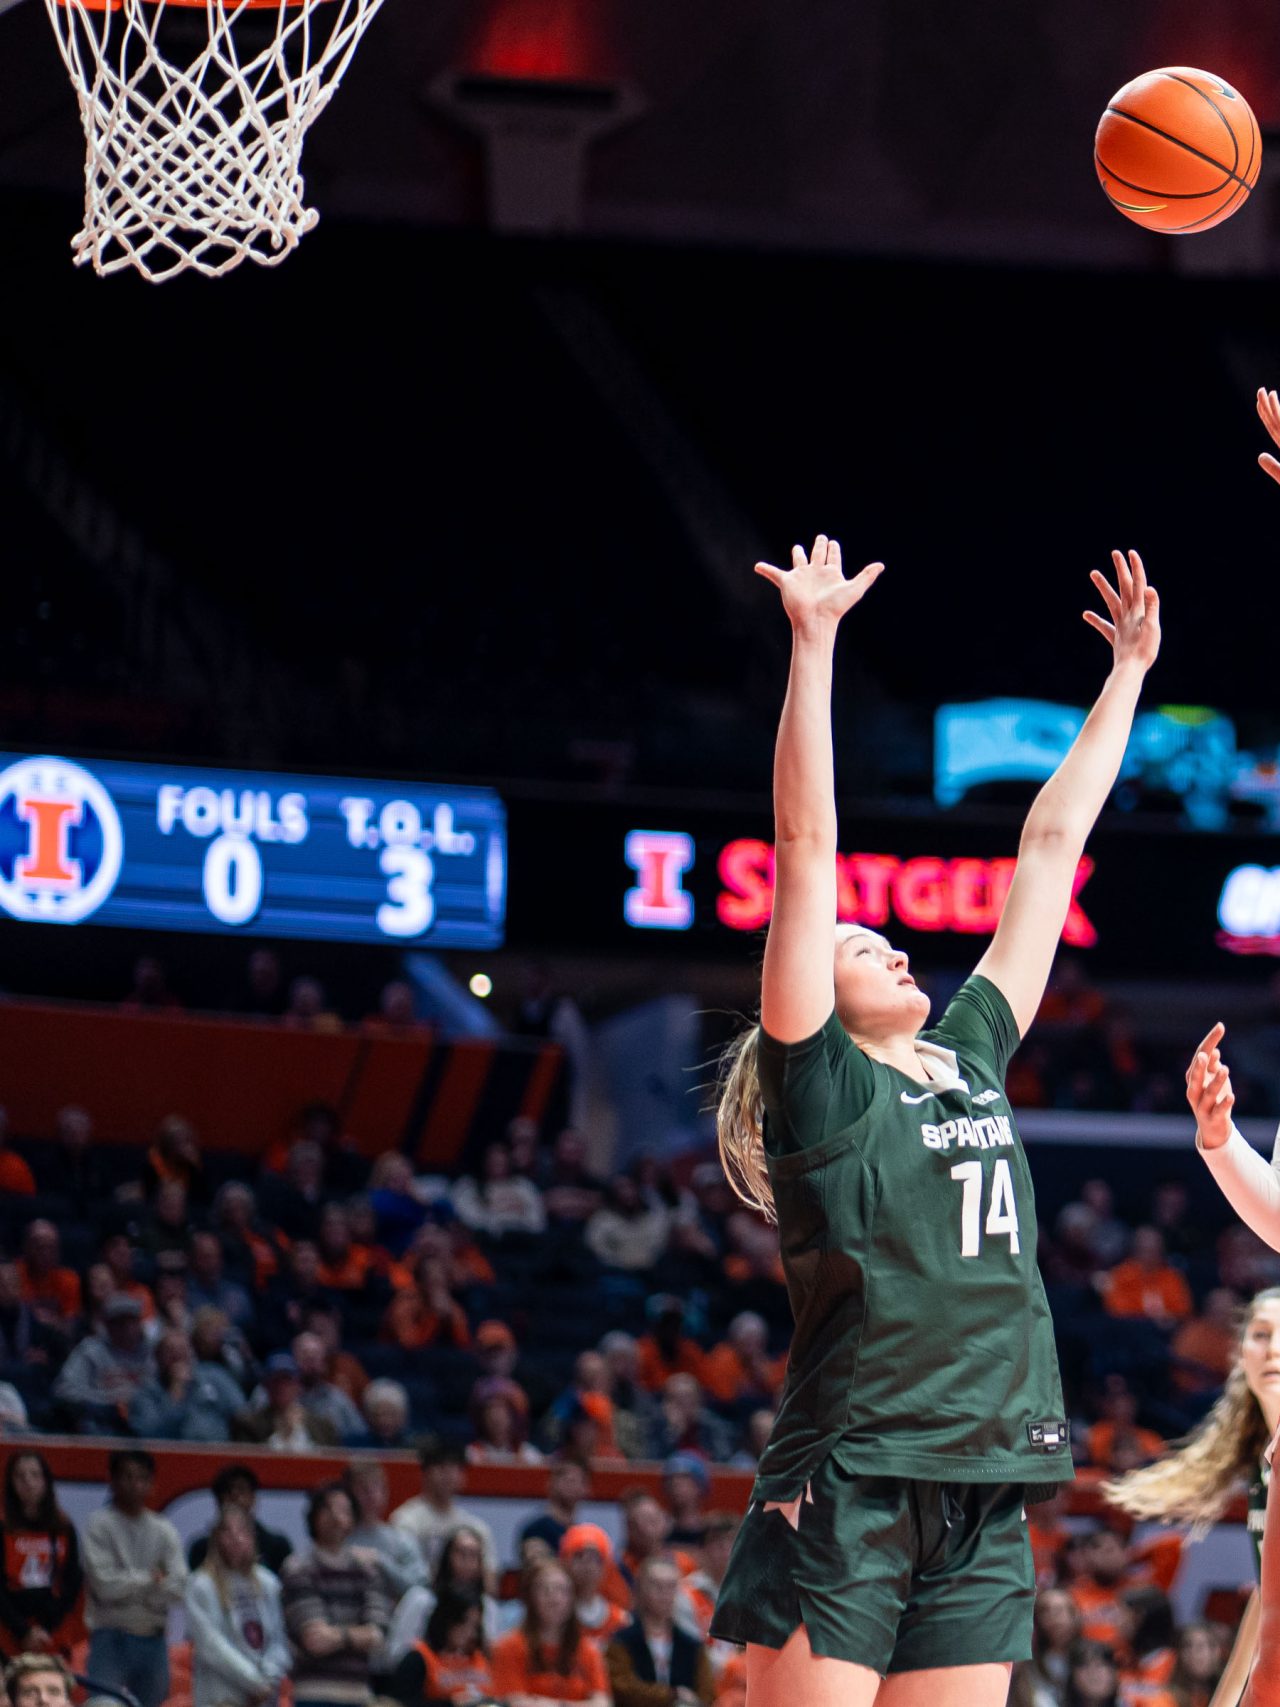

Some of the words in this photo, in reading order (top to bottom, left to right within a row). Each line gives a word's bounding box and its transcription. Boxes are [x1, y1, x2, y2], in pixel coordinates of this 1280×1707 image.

[157, 785, 308, 844] FOULS
[340, 797, 475, 856] T.O.L.
[203, 833, 263, 926] 0
[376, 844, 434, 937] 3
[950, 1159, 1021, 1257] 14
